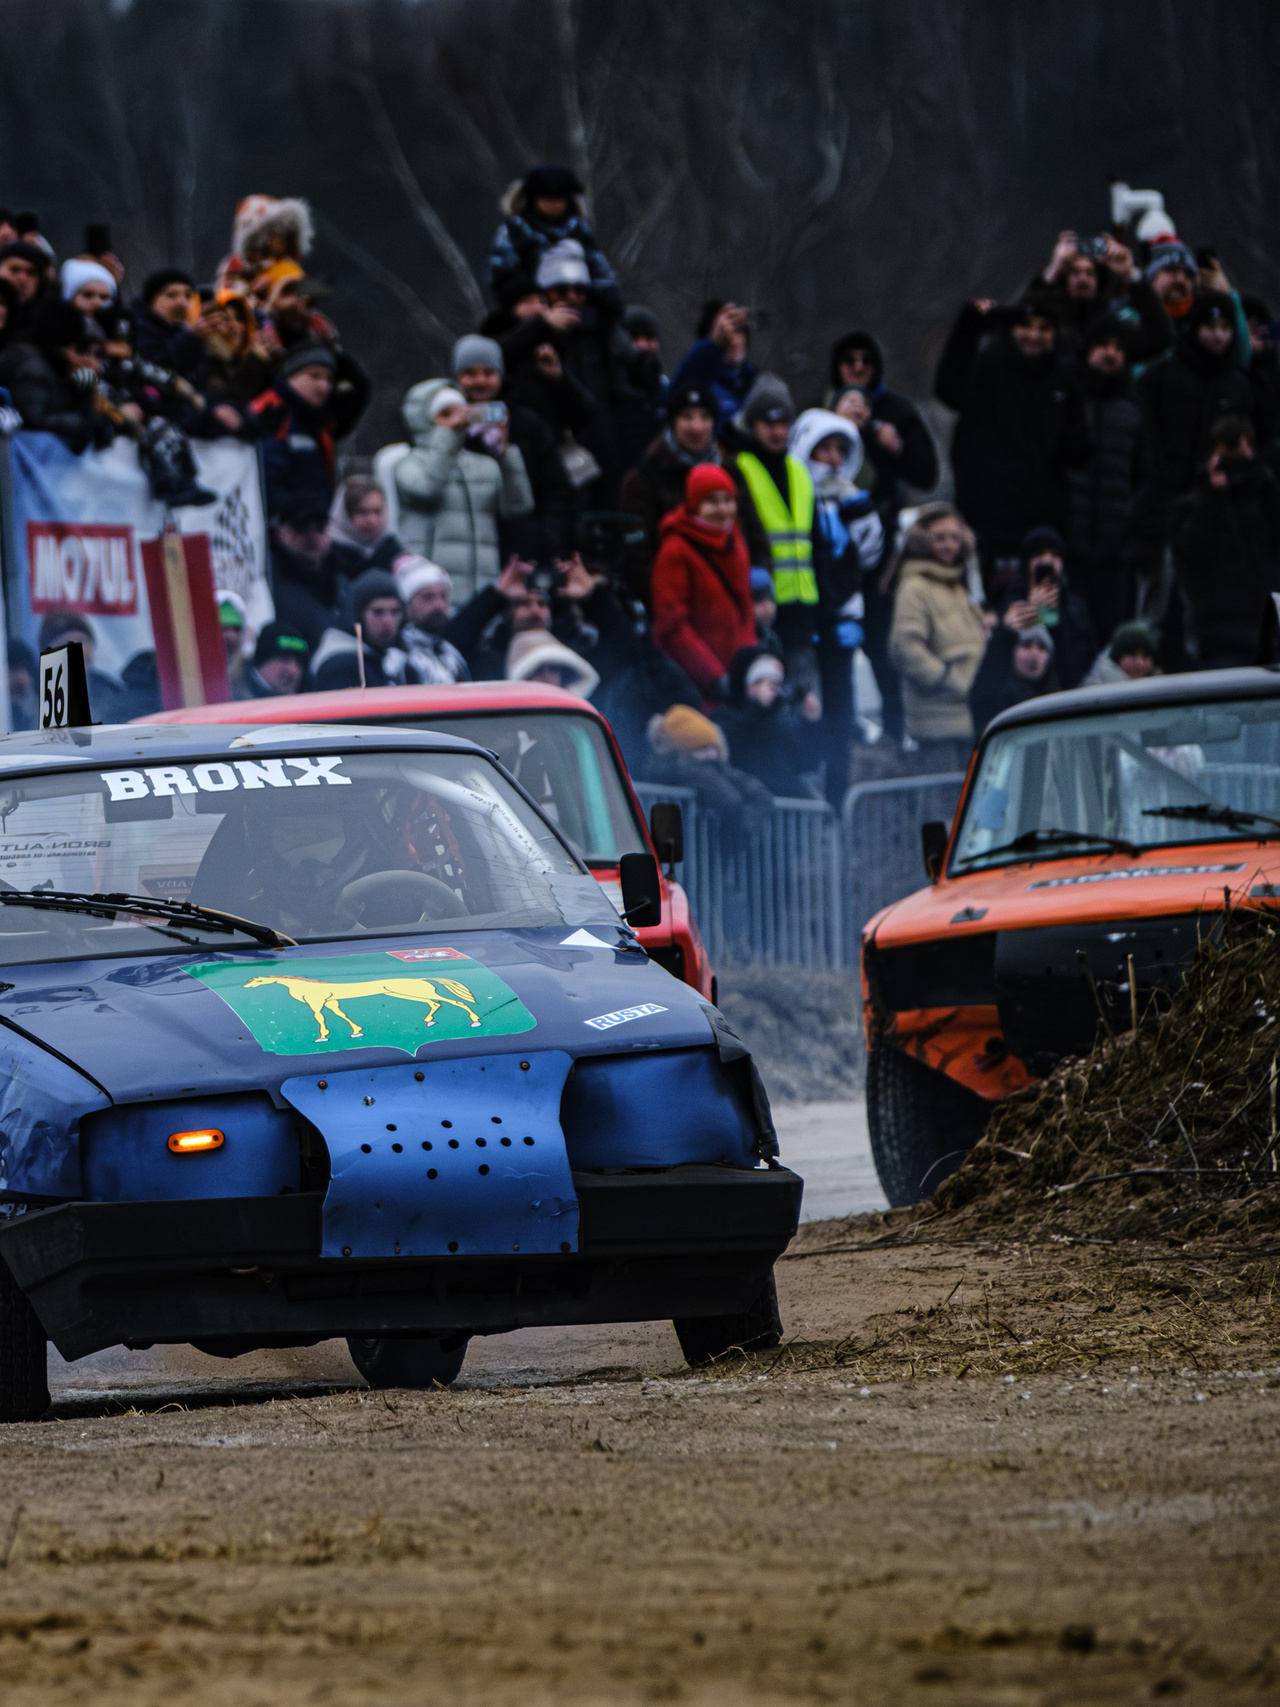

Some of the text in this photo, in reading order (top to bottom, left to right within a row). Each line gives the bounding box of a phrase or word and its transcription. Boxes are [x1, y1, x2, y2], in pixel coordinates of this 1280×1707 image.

[34, 534, 135, 604] MOTUL
[43, 663, 65, 728] 56
[100, 756, 353, 801] BRONX
[591, 1004, 664, 1028] RUSTA
